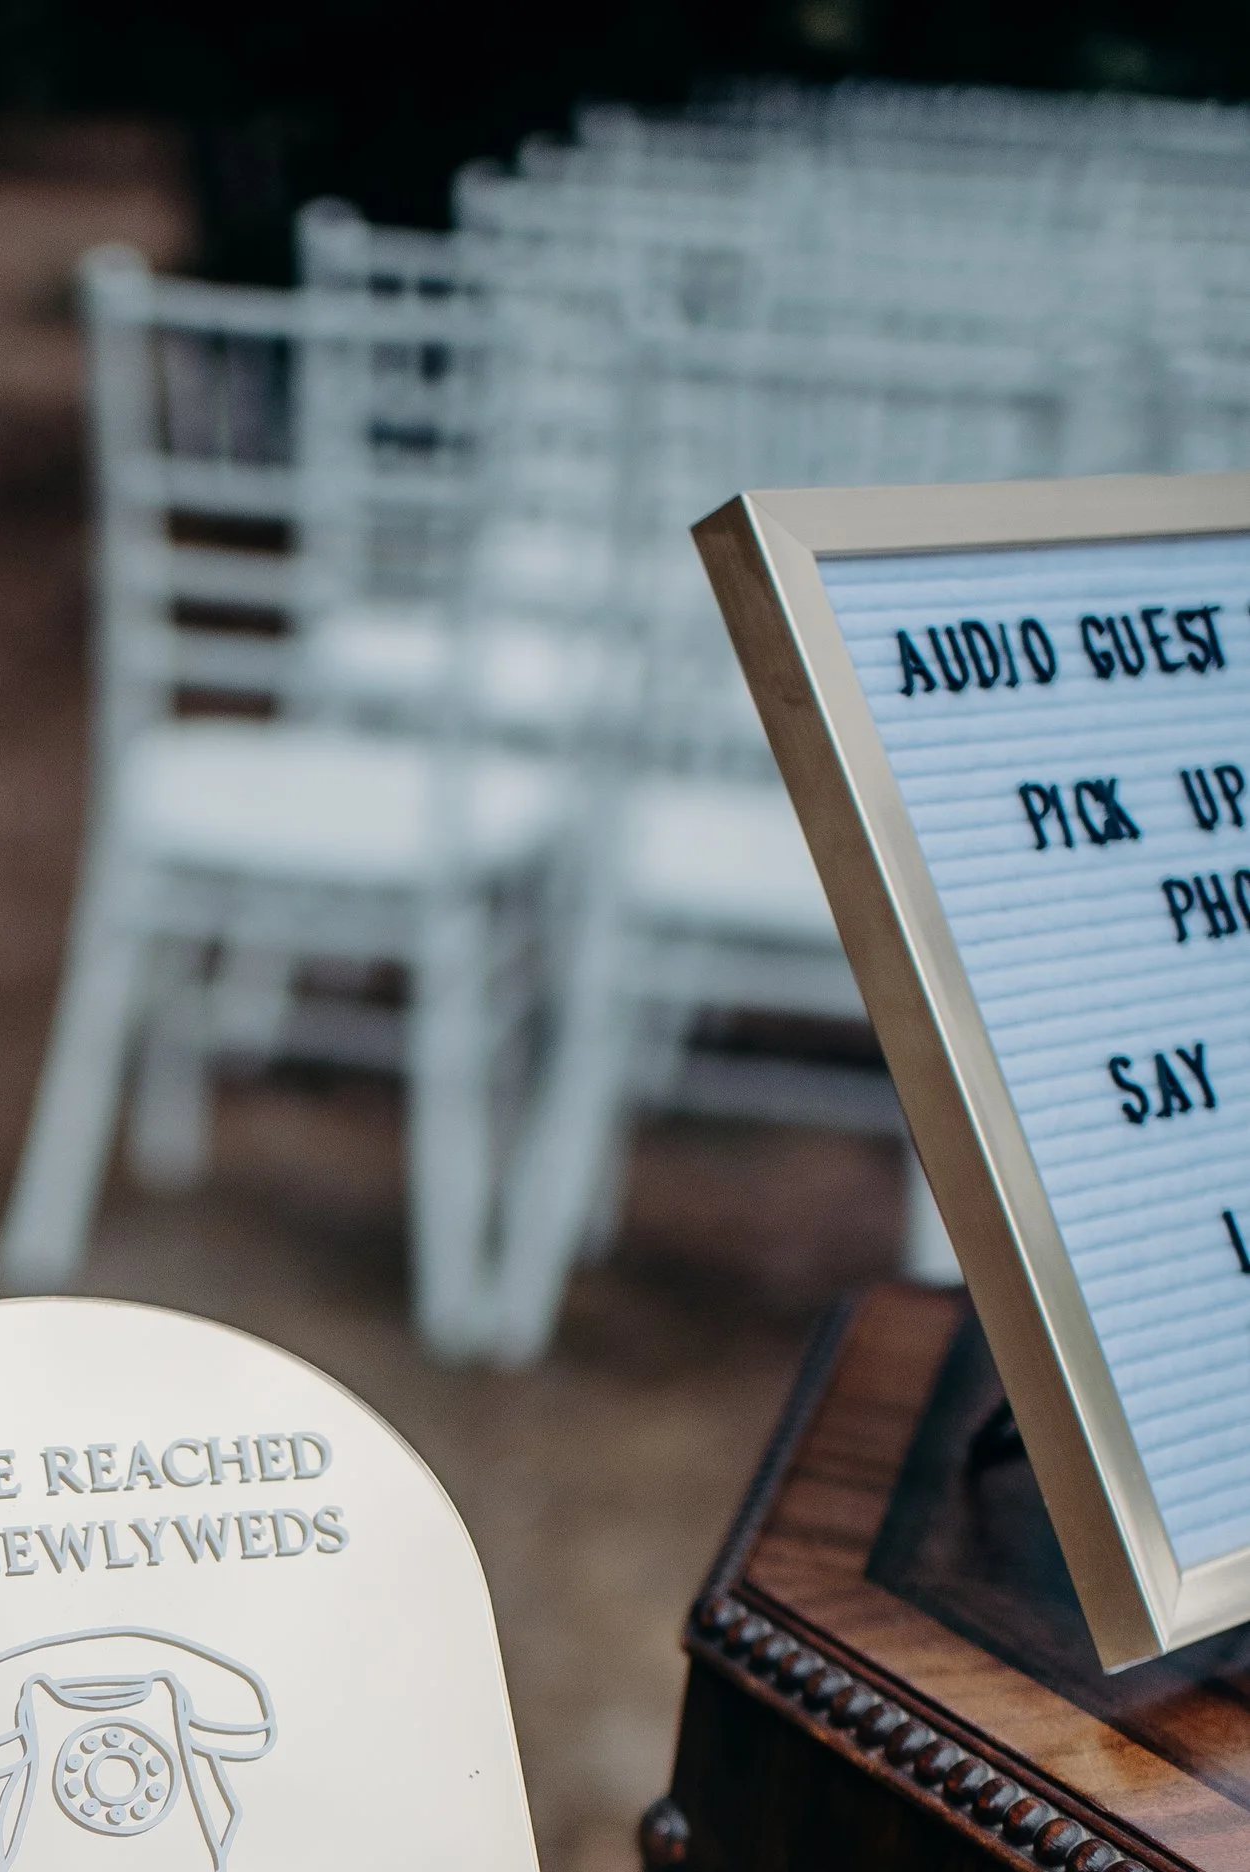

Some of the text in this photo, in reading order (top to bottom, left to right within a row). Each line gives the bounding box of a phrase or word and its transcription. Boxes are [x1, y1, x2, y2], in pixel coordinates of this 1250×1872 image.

[895, 605, 1226, 698] AUDIO GUEST
[1018, 765, 1246, 850] PICK UP
[1108, 1043, 1219, 1125] SAY
[39, 1430, 334, 1498] REACHED
